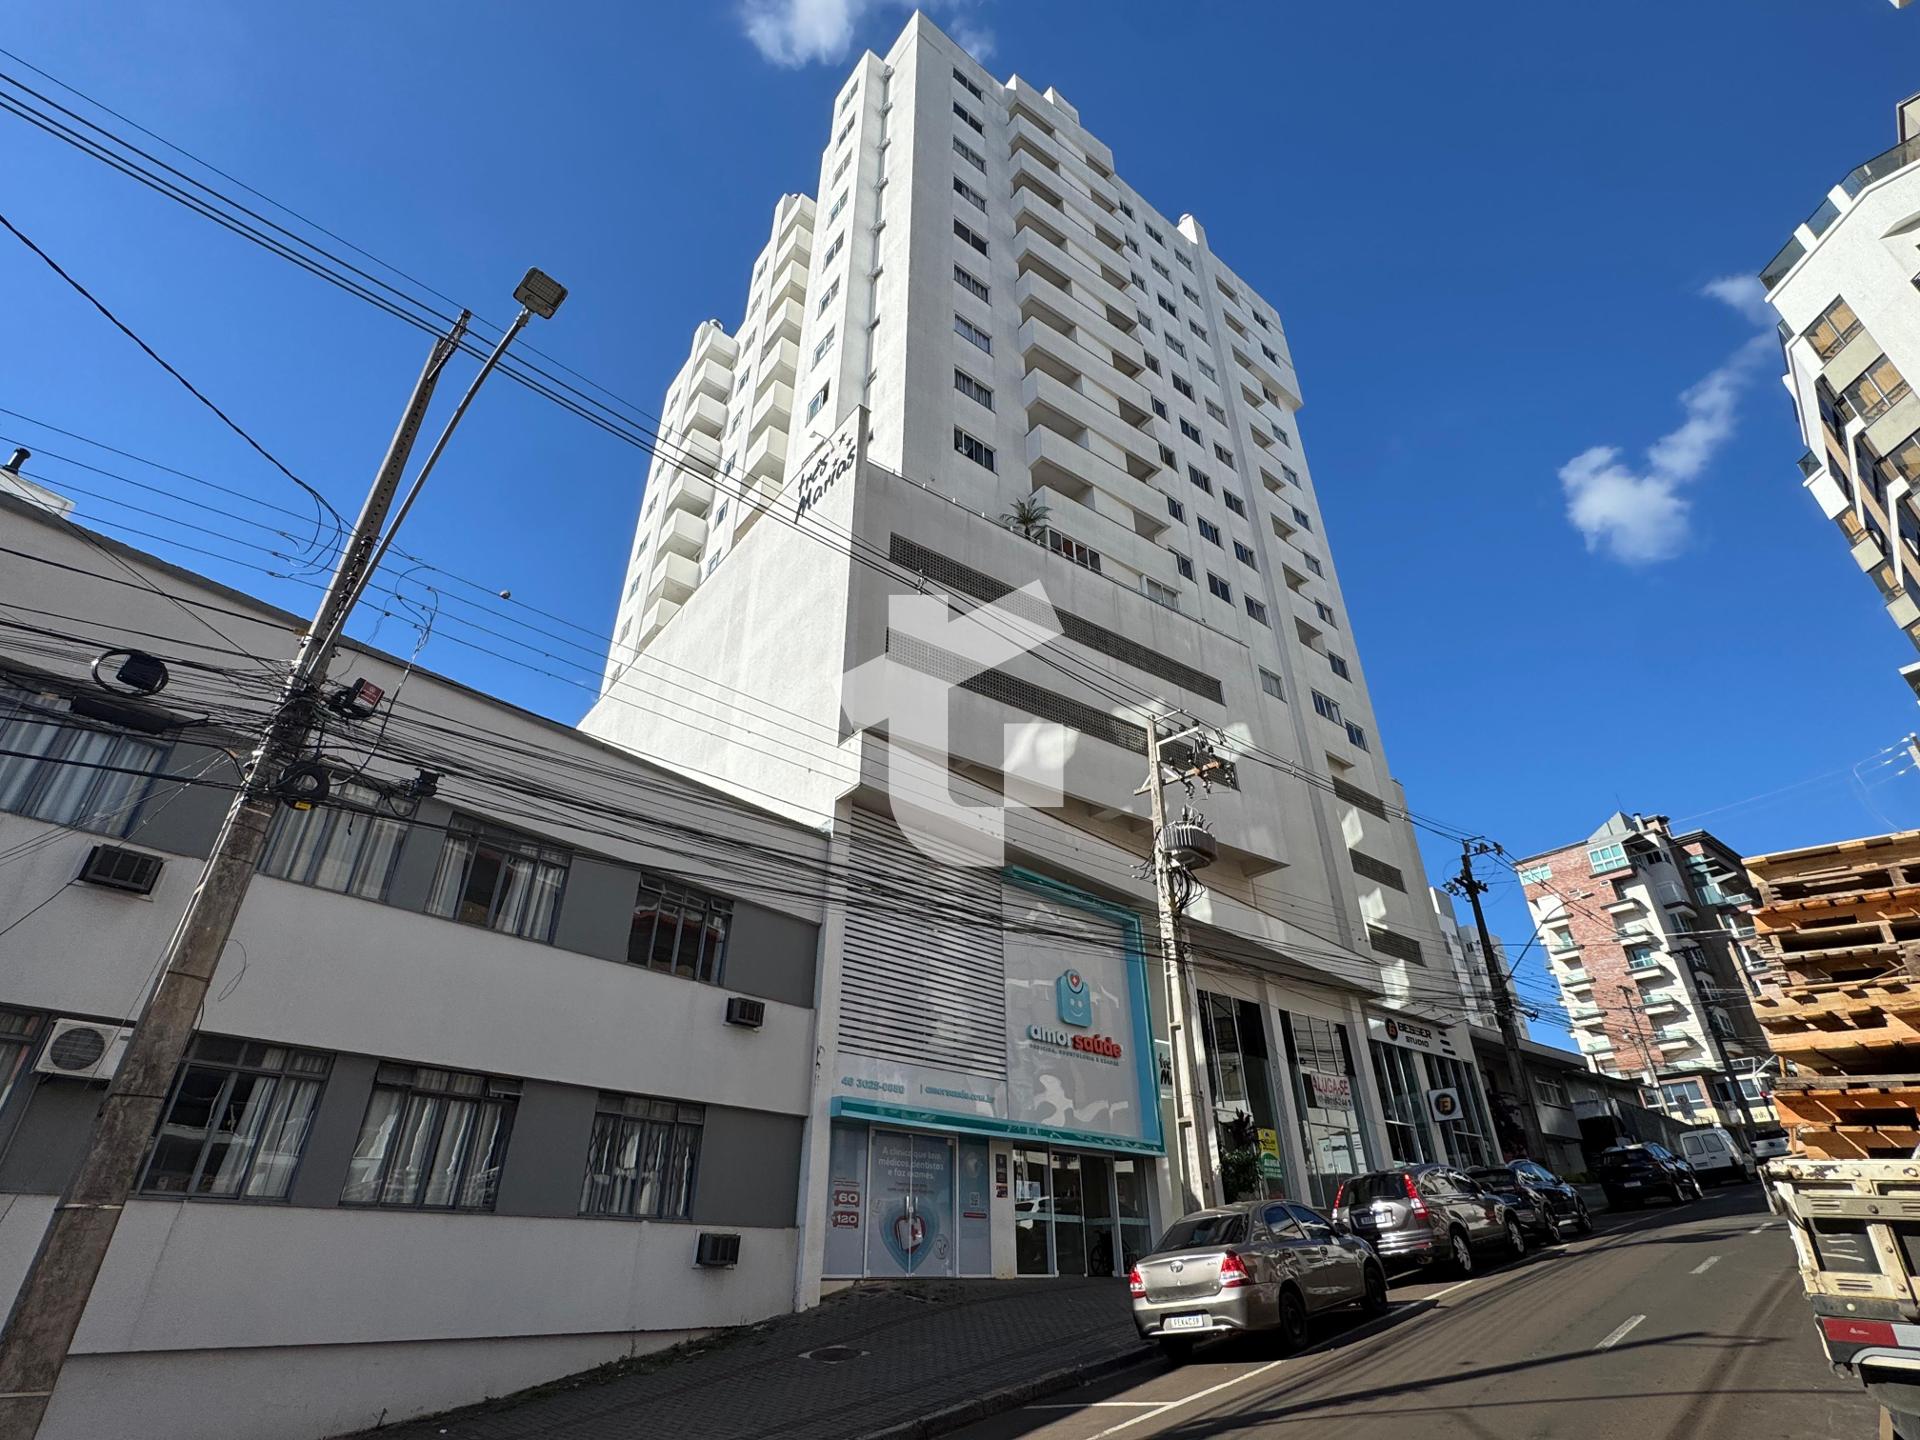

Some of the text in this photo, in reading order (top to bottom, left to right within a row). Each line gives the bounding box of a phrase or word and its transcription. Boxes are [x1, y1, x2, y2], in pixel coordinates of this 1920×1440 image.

[1397, 1021, 1432, 1039] BESSER
[1405, 1035, 1430, 1048] STUDIO
[838, 1193, 858, 1203] 60
[837, 1214, 857, 1224] 120
